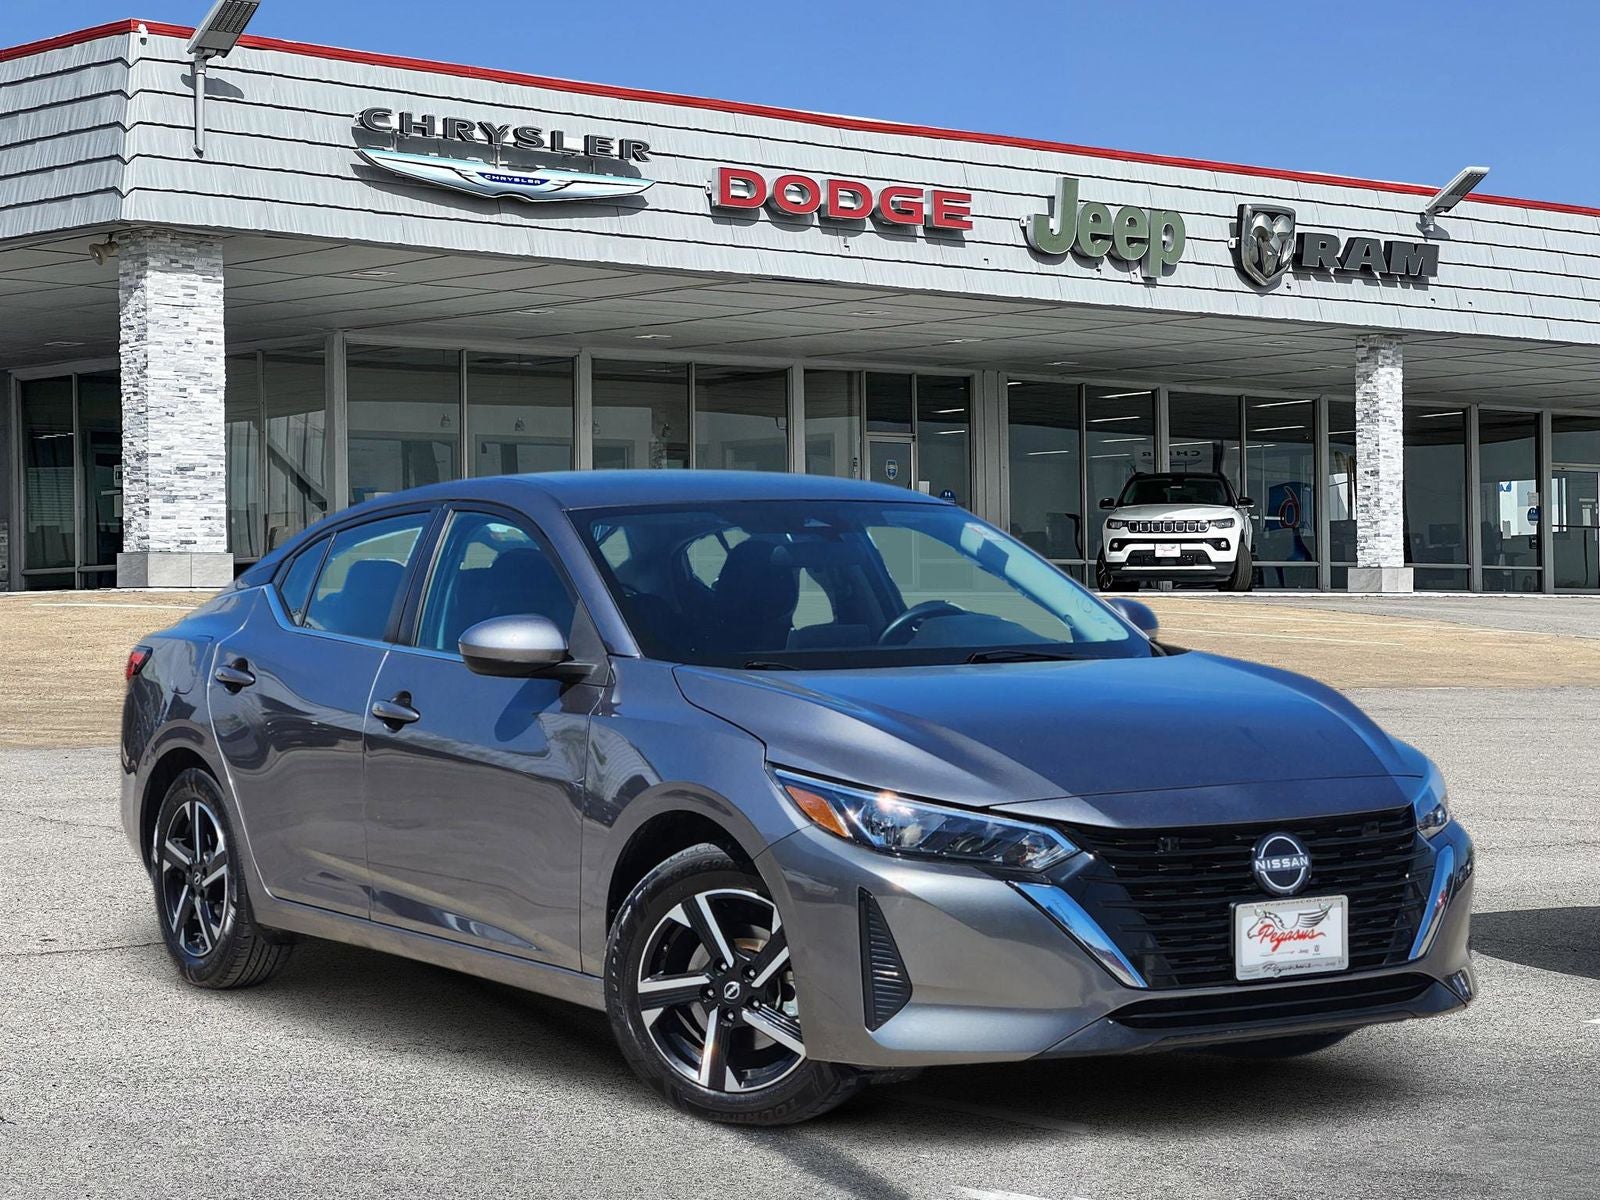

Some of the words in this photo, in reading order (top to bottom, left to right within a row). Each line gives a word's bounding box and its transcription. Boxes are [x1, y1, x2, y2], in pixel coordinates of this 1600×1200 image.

[358, 107, 651, 162] CHRYSLER
[484, 174, 541, 185] CHRYSLER
[713, 166, 974, 231] DODGE
[1026, 177, 1187, 279] Jeep
[1296, 231, 1440, 278] RAM
[1255, 856, 1309, 870] NISSAN
[1258, 923, 1326, 952] Pegasus
